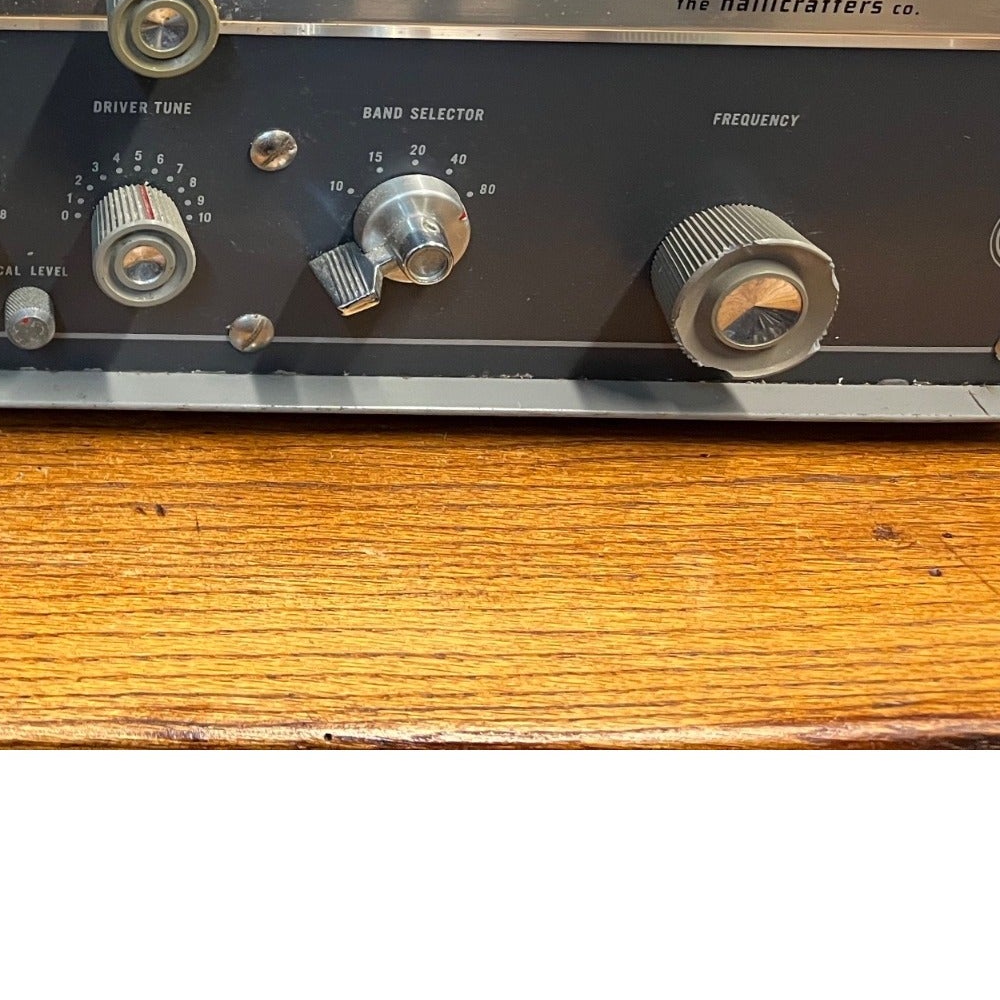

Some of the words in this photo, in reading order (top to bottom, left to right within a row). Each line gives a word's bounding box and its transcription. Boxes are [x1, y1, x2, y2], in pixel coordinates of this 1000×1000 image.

[892, 2, 920, 16] co.
[93, 100, 148, 114] DRIVER
[154, 101, 192, 115] TUNE
[362, 106, 403, 120] BAND
[409, 107, 485, 122] SELECTOR
[712, 112, 800, 128] FREQUENCY
[134, 150, 143, 161] 5
[409, 144, 426, 156] 20
[112, 152, 120, 163] 4
[156, 153, 165, 165] 6
[368, 151, 383, 163] 15
[450, 153, 467, 165] 40
[91, 161, 99, 172] 3
[176, 163, 184, 174] 7
[74, 175, 83, 186] 2
[189, 176, 197, 188] 8
[329, 180, 344, 191] 10
[479, 184, 496, 195] 80
[66, 193, 72, 203] 1
[197, 195, 205, 206] 9
[0, 209, 7, 220] 8
[61, 210, 69, 220] 0
[198, 212, 212, 223] 10
[30, 265, 68, 277] LEVEL
